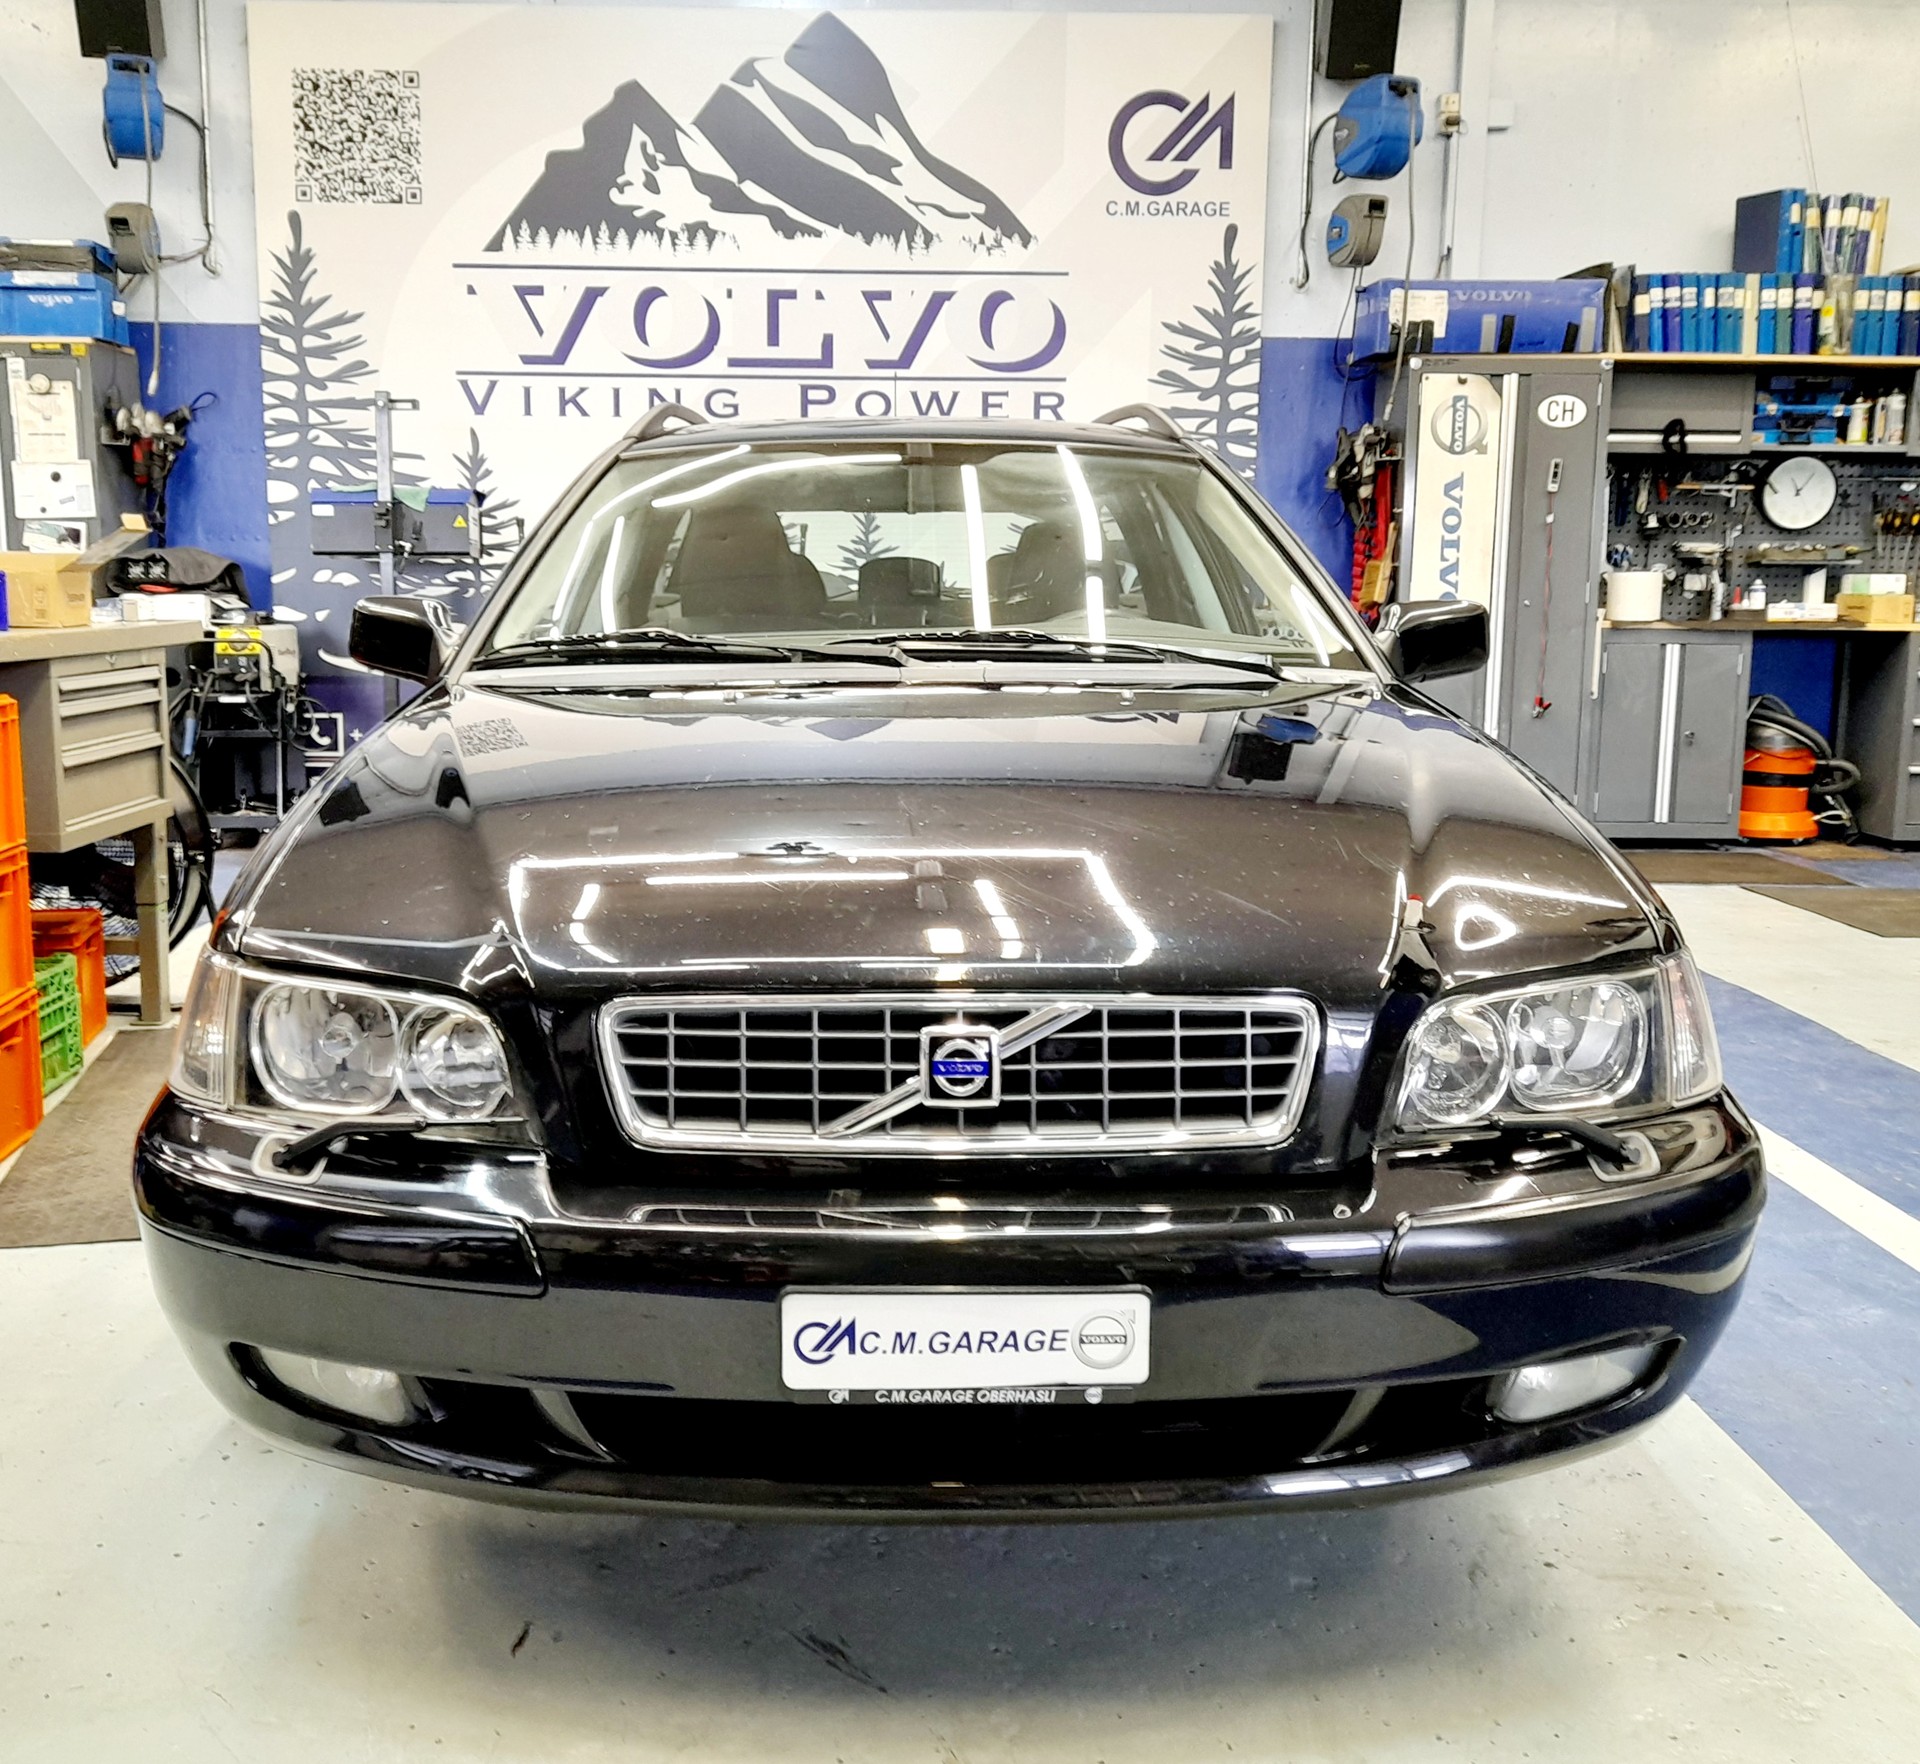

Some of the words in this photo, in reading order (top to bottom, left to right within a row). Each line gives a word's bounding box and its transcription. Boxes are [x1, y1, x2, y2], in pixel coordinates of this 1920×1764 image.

[1106, 201, 1230, 217] C.M.GARAGE
[1454, 290, 1532, 302] VOLVO
[462, 283, 1066, 372] VOLVO
[1547, 400, 1575, 422] CH
[1453, 399, 1467, 453] VOLVO
[859, 1329, 1069, 1355] C.M.GARAGE
[1080, 1335, 1126, 1344] VOLVO
[874, 1389, 974, 1404] C.M.GARAGE
[976, 1389, 1056, 1404] OBERHASLI
